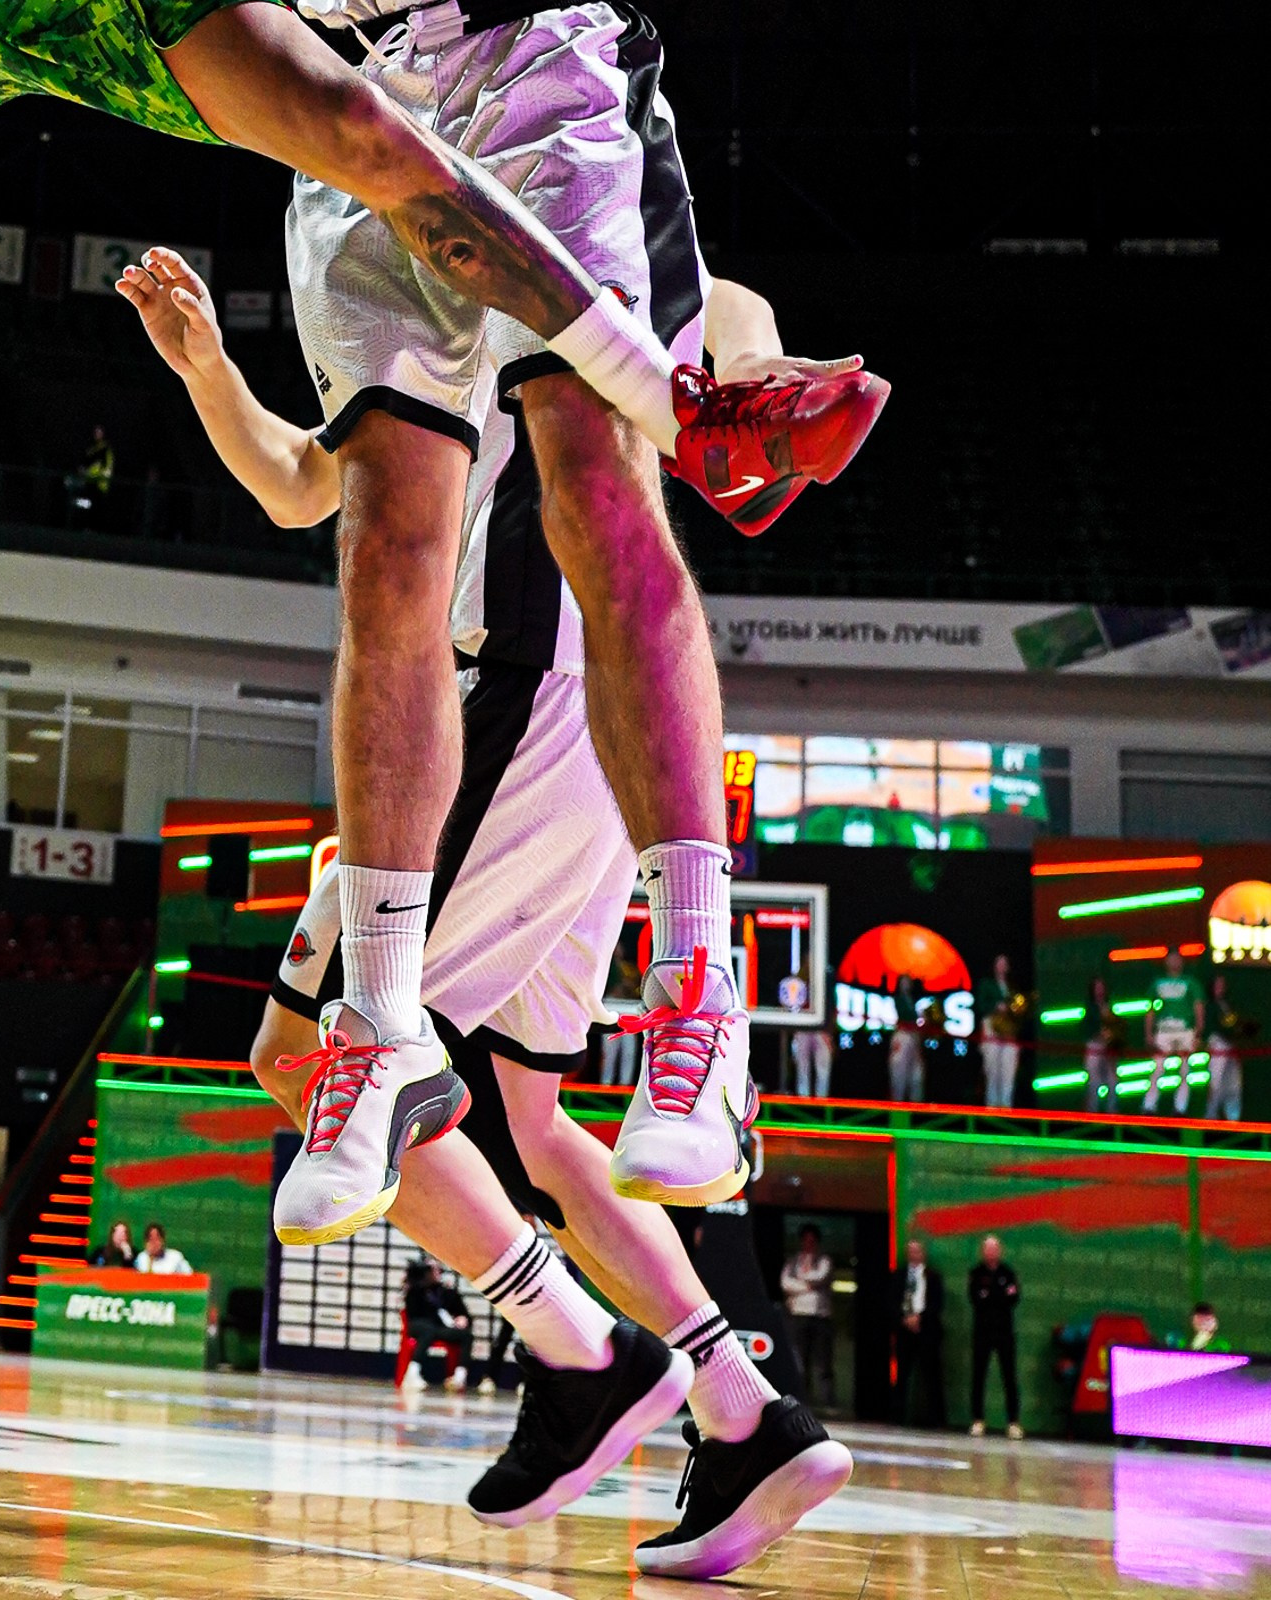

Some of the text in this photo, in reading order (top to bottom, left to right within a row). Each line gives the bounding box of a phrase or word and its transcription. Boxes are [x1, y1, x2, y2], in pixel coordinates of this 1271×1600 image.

[816, 621, 890, 645] ЖИТЬ
[892, 622, 982, 646] ЛУЧШЕ
[30, 837, 96, 878] 1-3
[65, 1293, 176, 1327] ПРЕСС-ЗОНА
